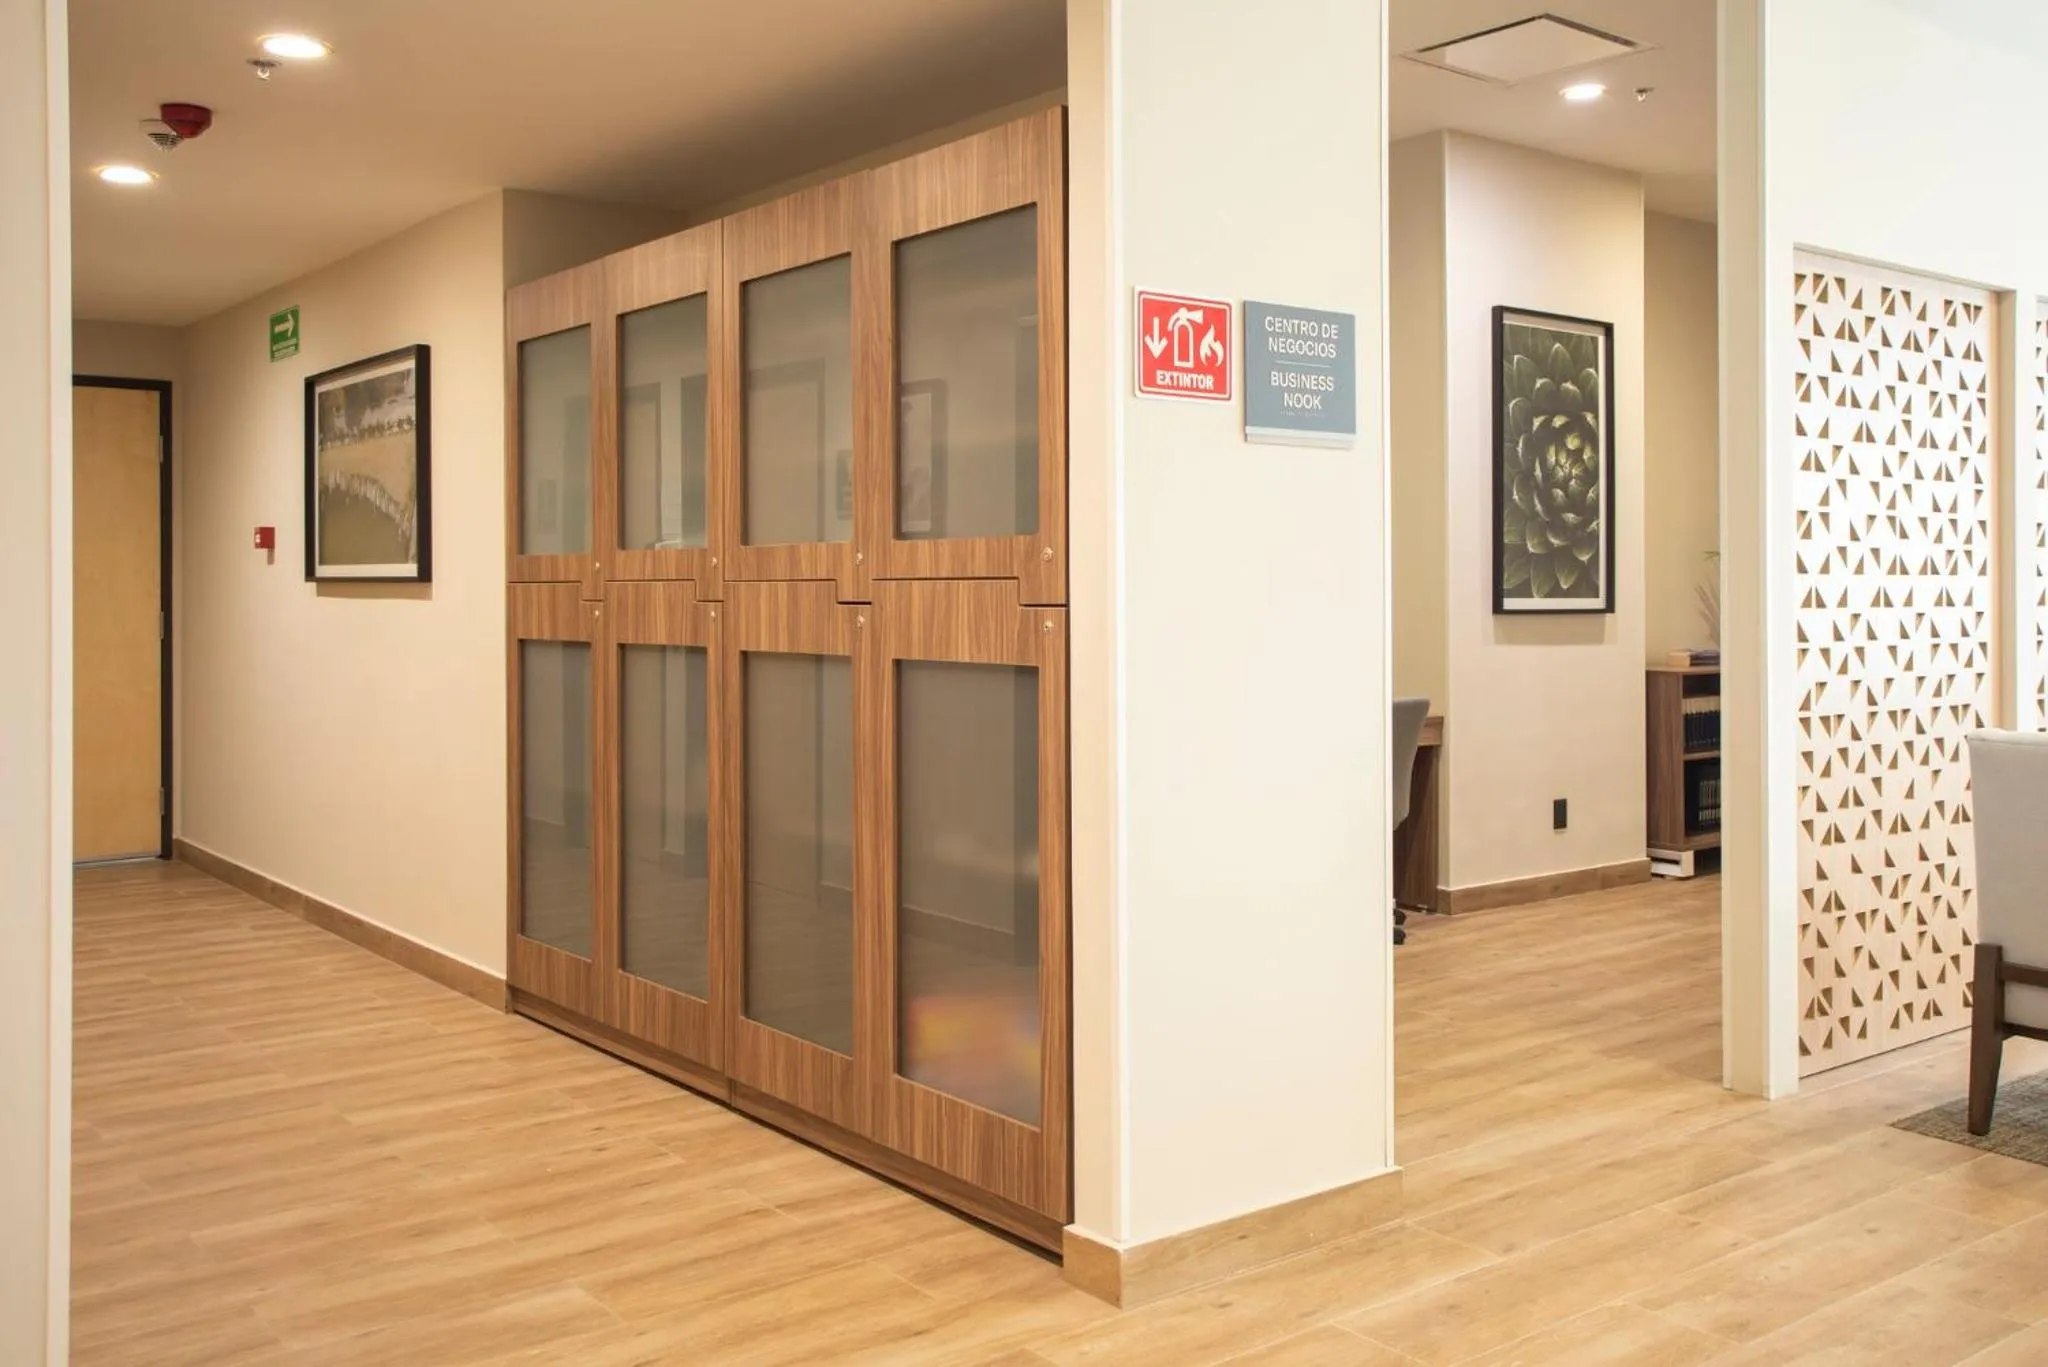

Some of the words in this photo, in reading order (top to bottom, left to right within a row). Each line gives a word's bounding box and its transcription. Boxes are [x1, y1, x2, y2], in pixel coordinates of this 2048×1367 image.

[1265, 316, 1318, 337] CENTRO
[1322, 323, 1339, 339] DE
[1268, 337, 1336, 358] NEGOCIOS
[1156, 369, 1214, 390] EXTINTOR
[1270, 371, 1334, 391] BUSINESS
[1284, 392, 1322, 410] NOOK
